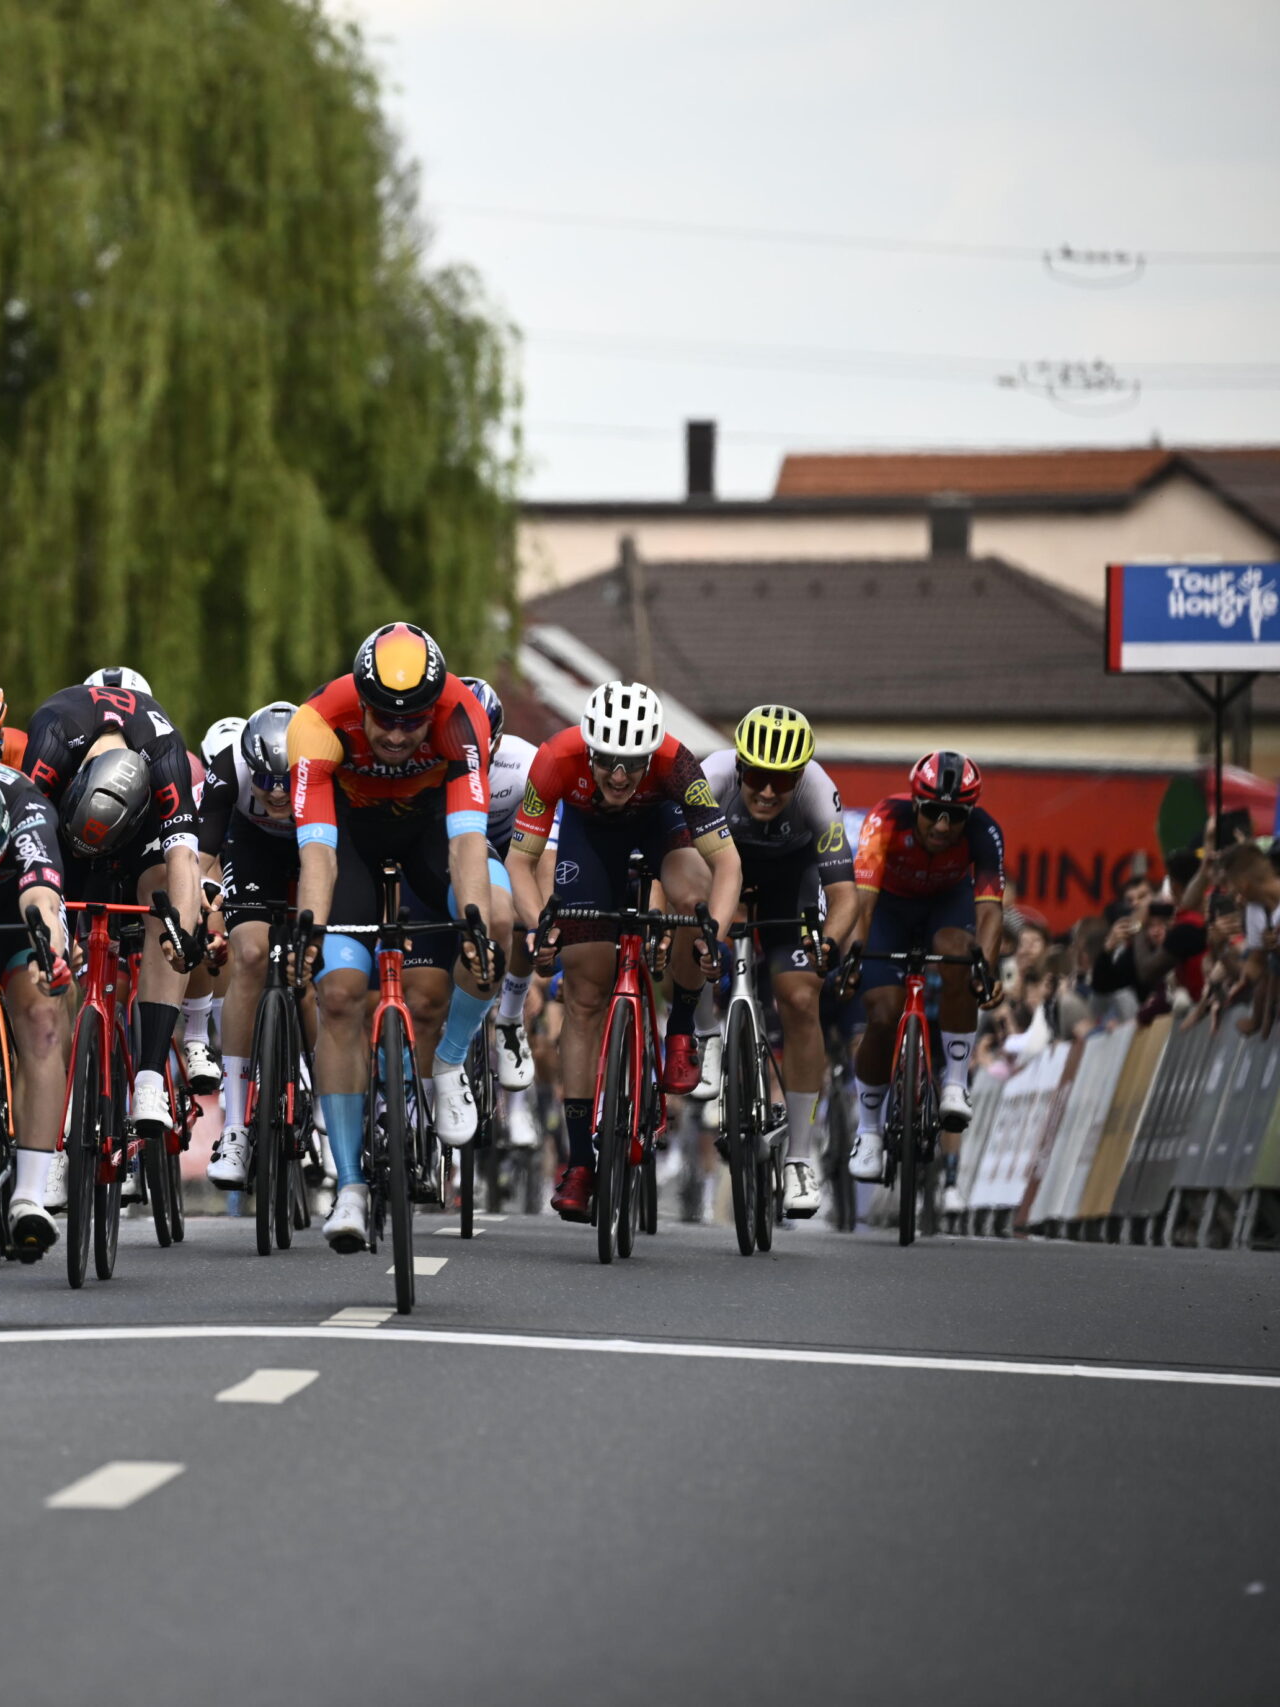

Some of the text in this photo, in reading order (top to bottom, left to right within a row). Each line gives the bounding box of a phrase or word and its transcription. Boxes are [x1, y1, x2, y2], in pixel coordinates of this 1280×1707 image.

[1166, 567, 1235, 595] Tour
[295, 756, 311, 819] MERIDA
[462, 743, 485, 805] MERIDA
